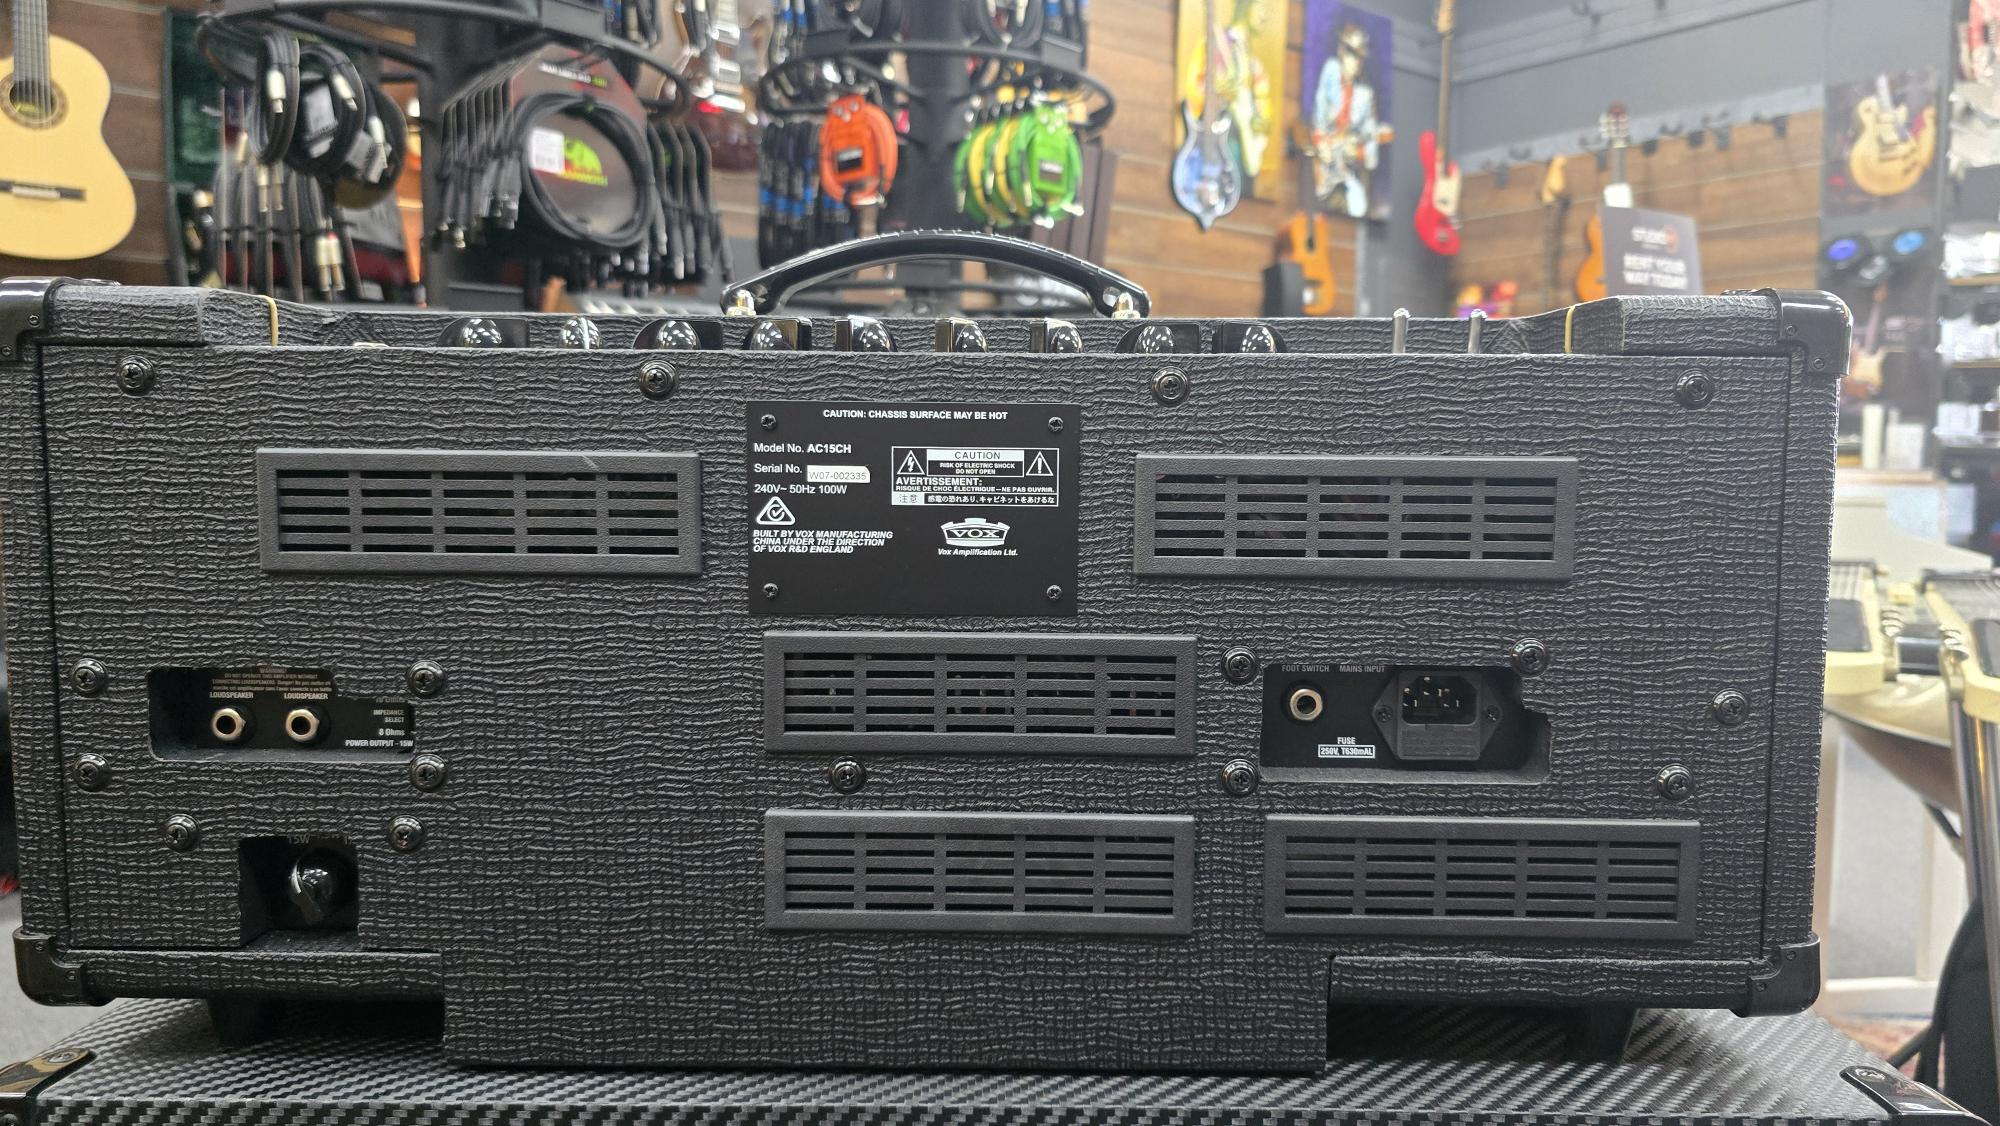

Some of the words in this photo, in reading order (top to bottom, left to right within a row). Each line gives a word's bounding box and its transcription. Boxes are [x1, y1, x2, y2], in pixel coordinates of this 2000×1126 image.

[823, 410, 866, 418] CAUTION:
[869, 410, 908, 419] CHASSIS
[910, 411, 951, 419] SURFACE
[989, 412, 1008, 420] HOT
[754, 443, 784, 452] Model
[787, 443, 804, 453] No.
[807, 444, 851, 453] AC15CH
[955, 451, 1000, 459] CAUTION
[754, 463, 783, 473] Serial
[786, 464, 802, 473] No.
[896, 477, 982, 486] AVERTISSEMENT:
[754, 484, 787, 493] 240V~
[790, 485, 815, 493] 50Hz
[819, 485, 847, 494] 100W
[899, 494, 918, 503] 注意
[795, 530, 814, 538] VOX
[816, 531, 893, 539] MANUFACTURING
[950, 529, 1000, 538] VOX
[788, 545, 808, 553] R&D
[809, 545, 854, 553] ENGLAND
[953, 548, 1002, 557] Amplification
[385, 728, 405, 736] Ohms
[1337, 737, 1356, 745] FUSE
[1321, 747, 1340, 756] 250V,
